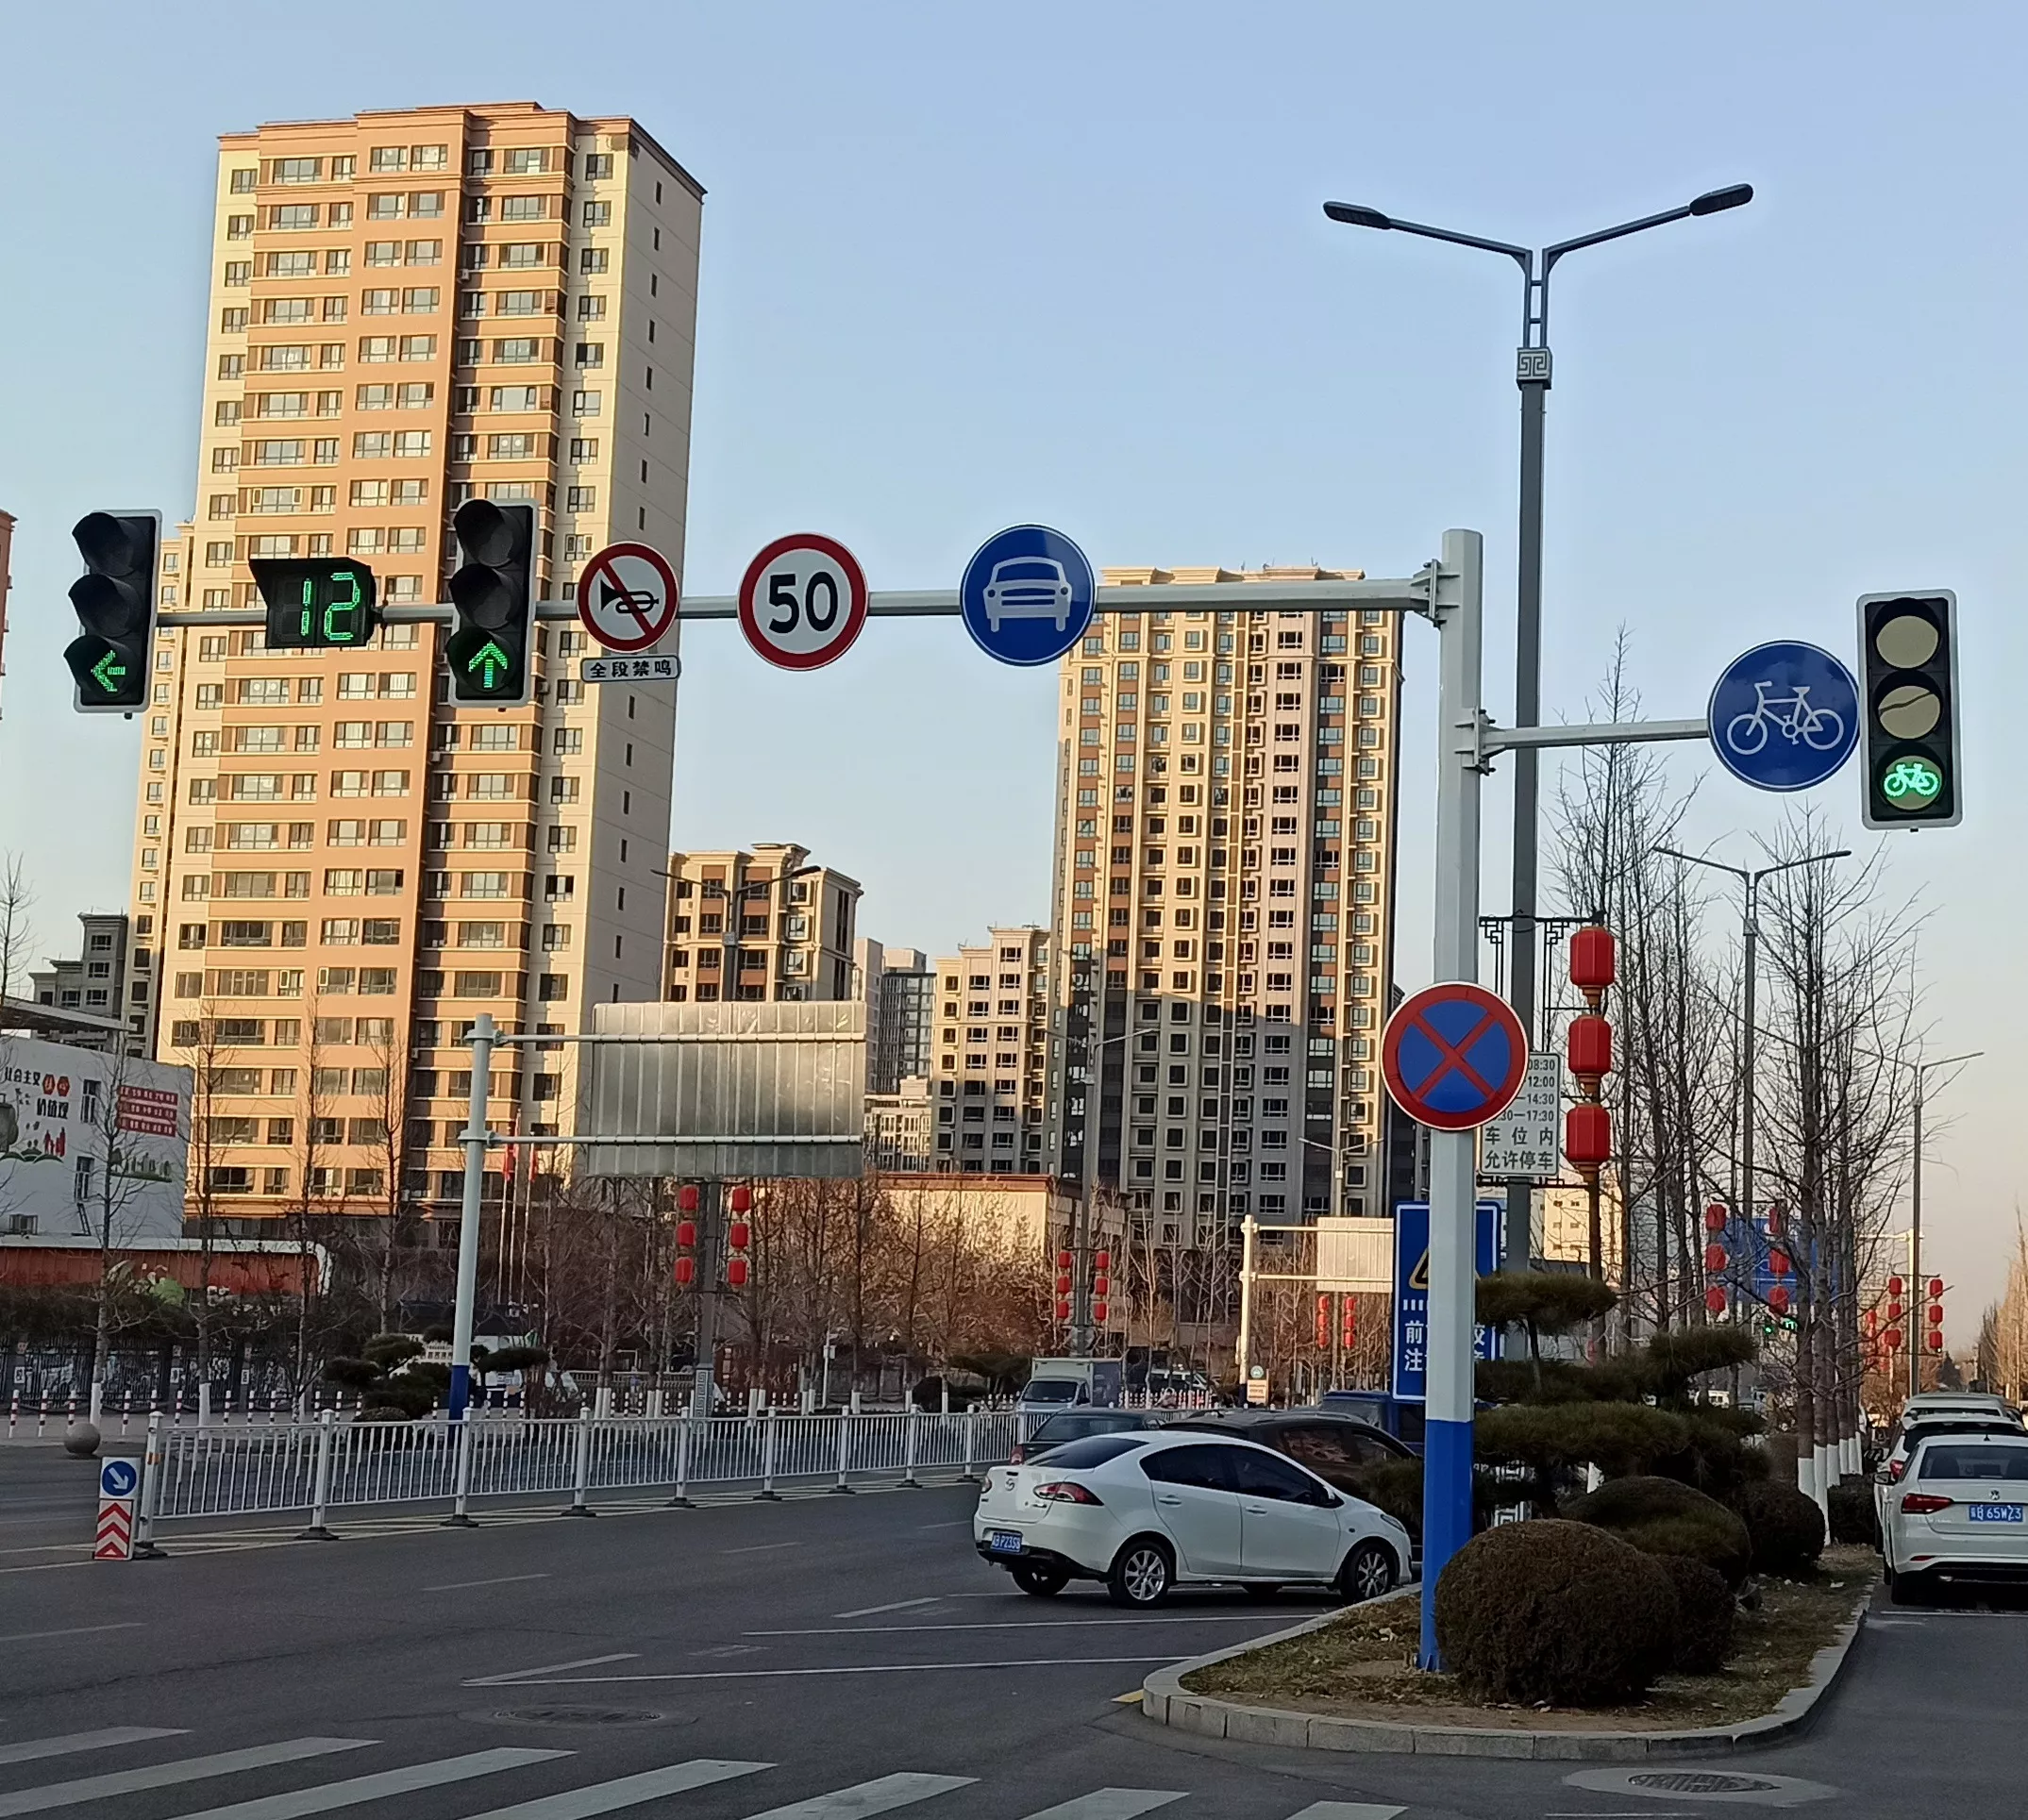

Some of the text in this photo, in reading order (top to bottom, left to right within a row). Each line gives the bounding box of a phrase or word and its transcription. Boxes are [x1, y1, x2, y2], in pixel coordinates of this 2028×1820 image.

[299, 571, 360, 643] 12
[768, 571, 839, 634] 50
[588, 659, 674, 680] 全段禁鸣
[1528, 1076, 1555, 1088] 12:00
[1484, 1126, 1554, 1146] 车位内
[1484, 1150, 1554, 1170] 允许停车
